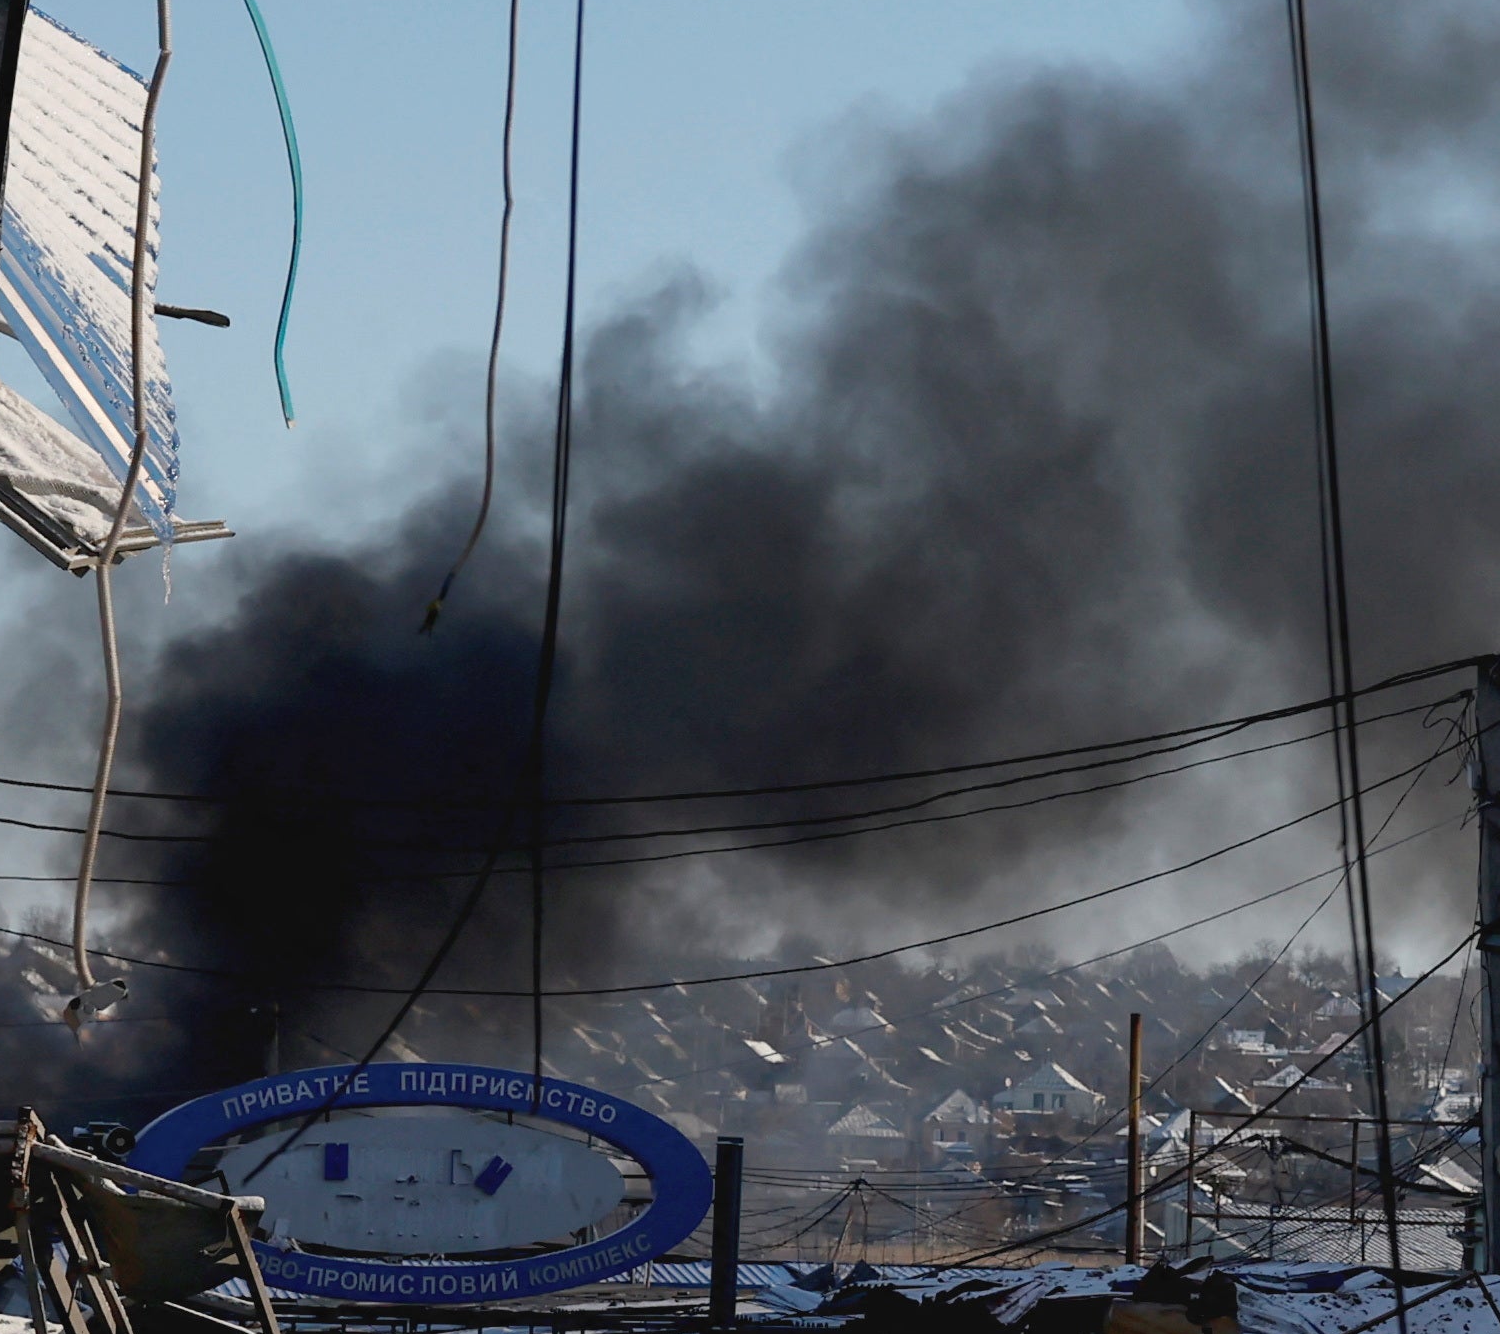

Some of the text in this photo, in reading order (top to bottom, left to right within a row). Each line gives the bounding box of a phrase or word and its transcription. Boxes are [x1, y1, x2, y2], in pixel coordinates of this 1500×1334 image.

[221, 1072, 370, 1120] ПРИВАТНЕ
[400, 1070, 617, 1124] ПІДПРИЄМСТВО
[255, 1234, 652, 1296] ОВО-ПРОМИСЛОВИЙ КОМПЛЕКС
